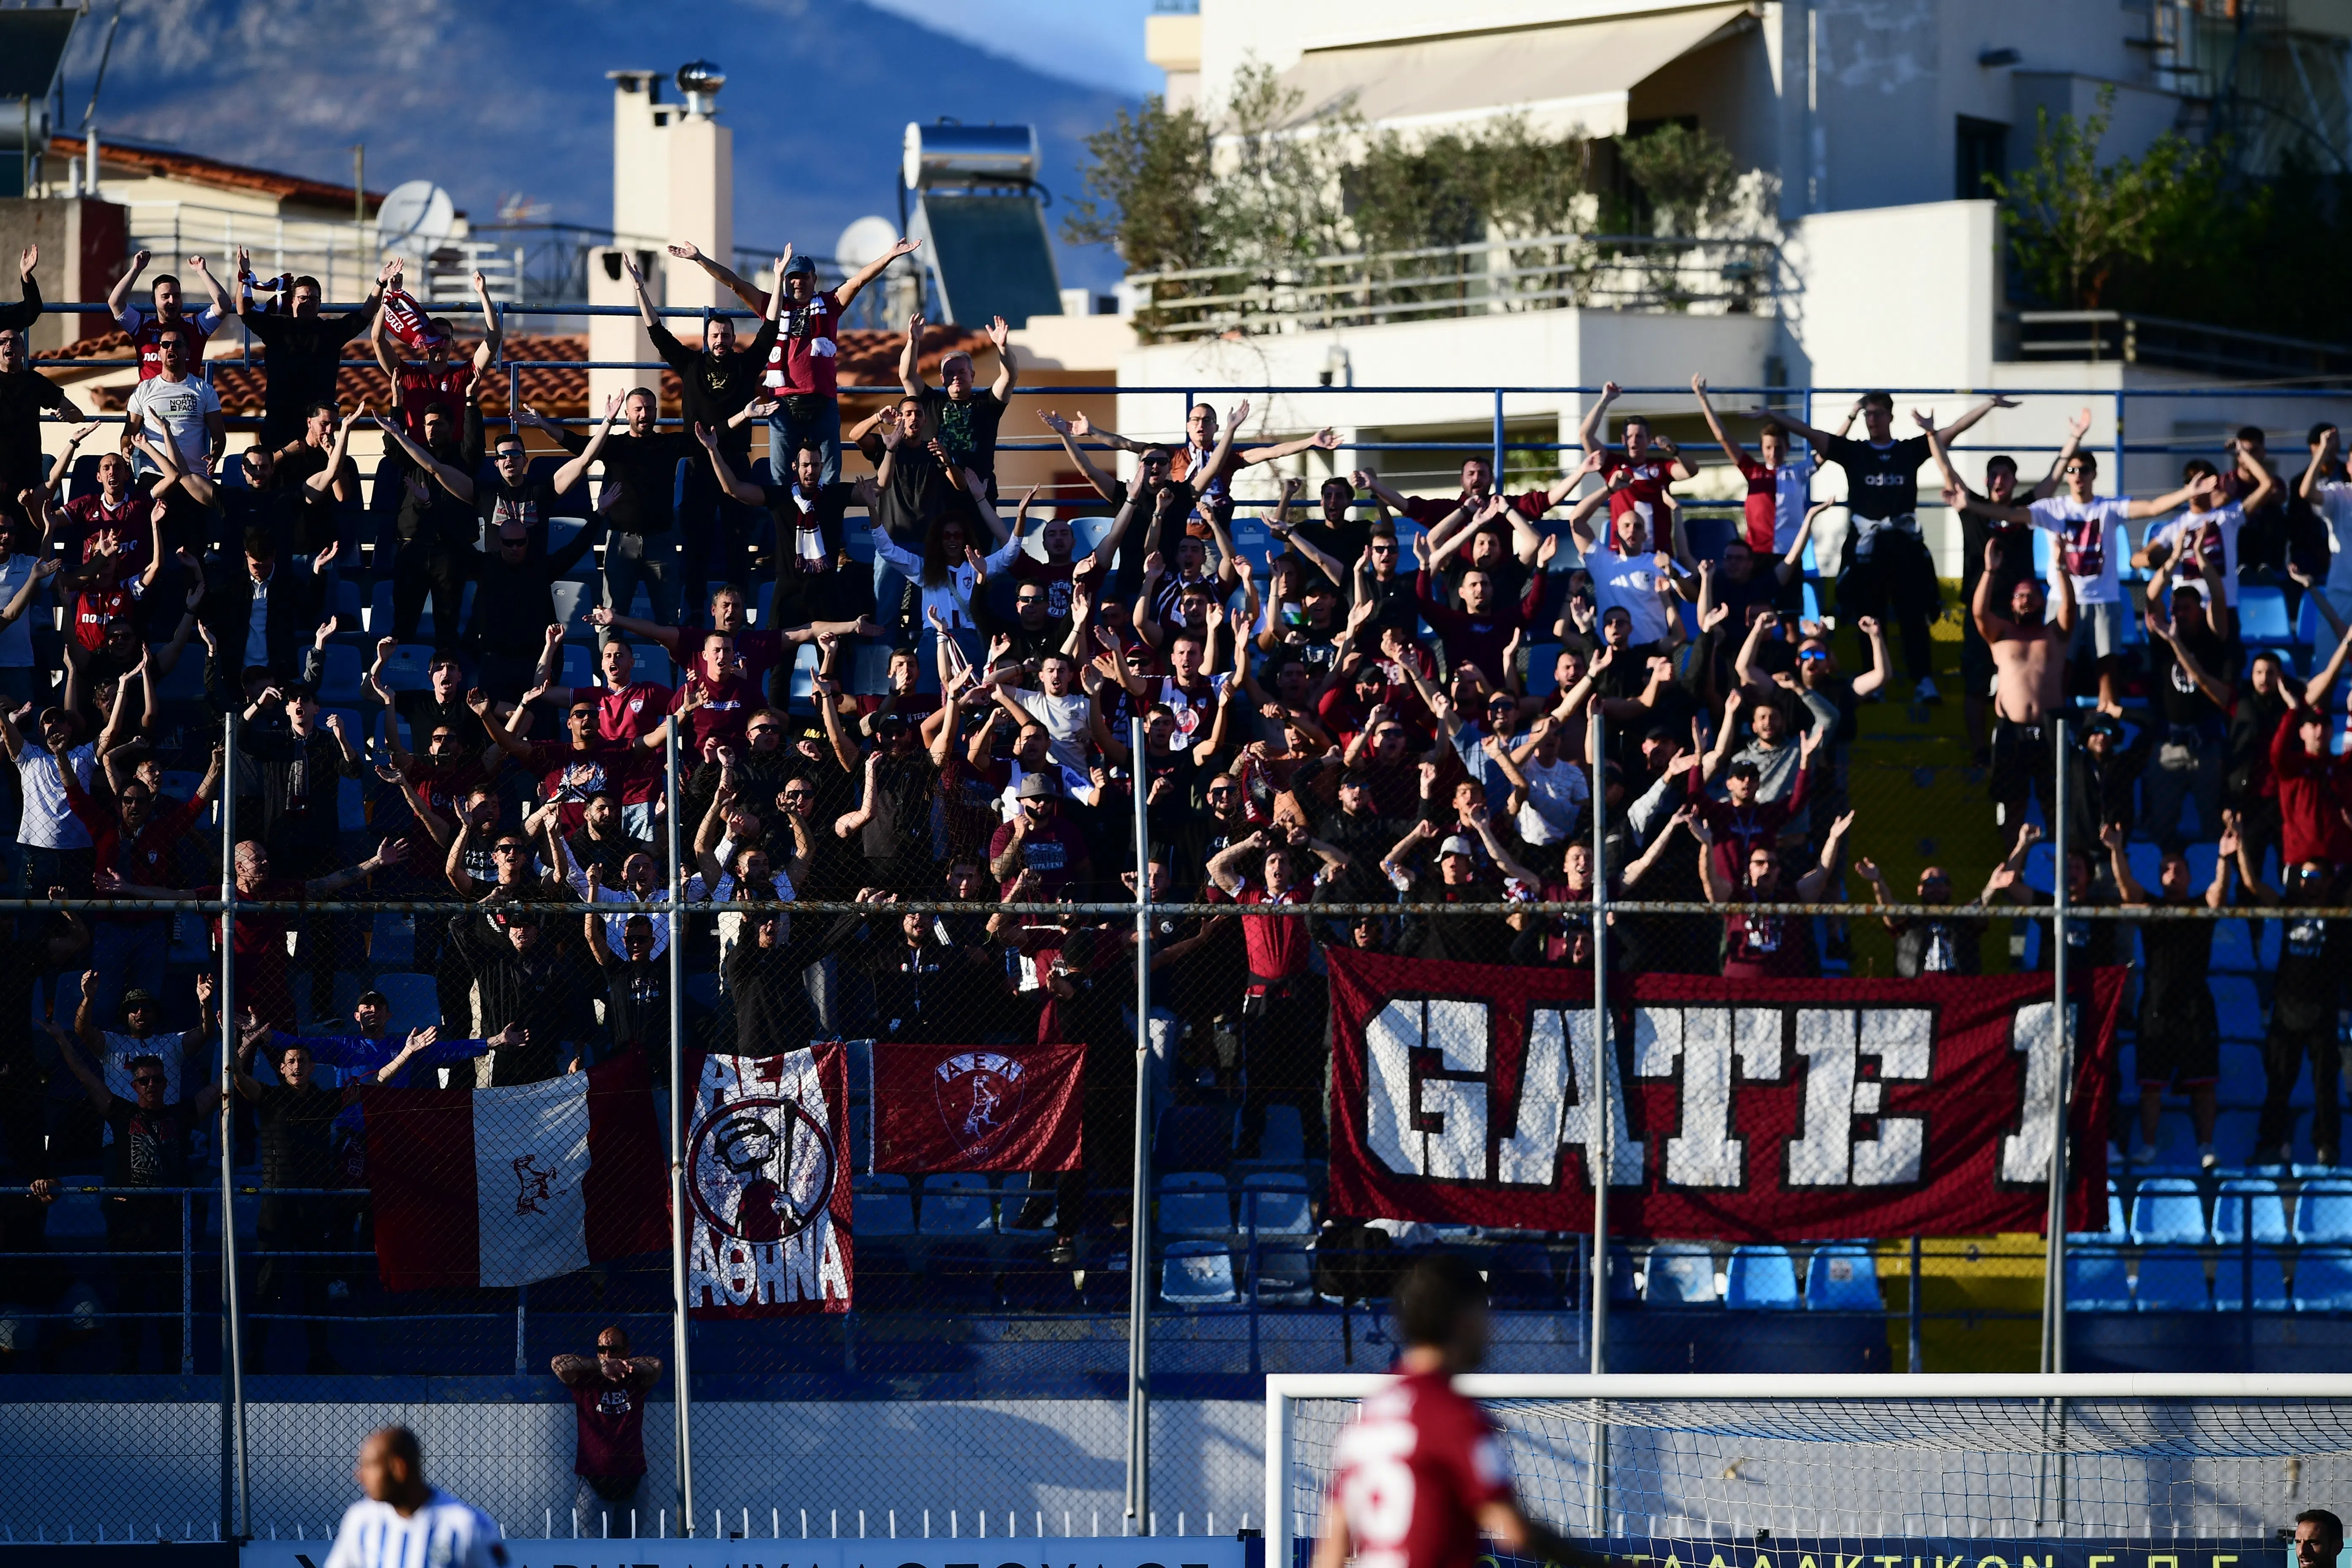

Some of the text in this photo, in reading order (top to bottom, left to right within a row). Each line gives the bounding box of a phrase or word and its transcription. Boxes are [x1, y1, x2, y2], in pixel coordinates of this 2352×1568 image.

[946, 1053, 1013, 1078] ΑΕΛ
[1365, 998, 2077, 1187] GATE 1
[689, 1217, 849, 1308] ΑΘΗΝΑ
